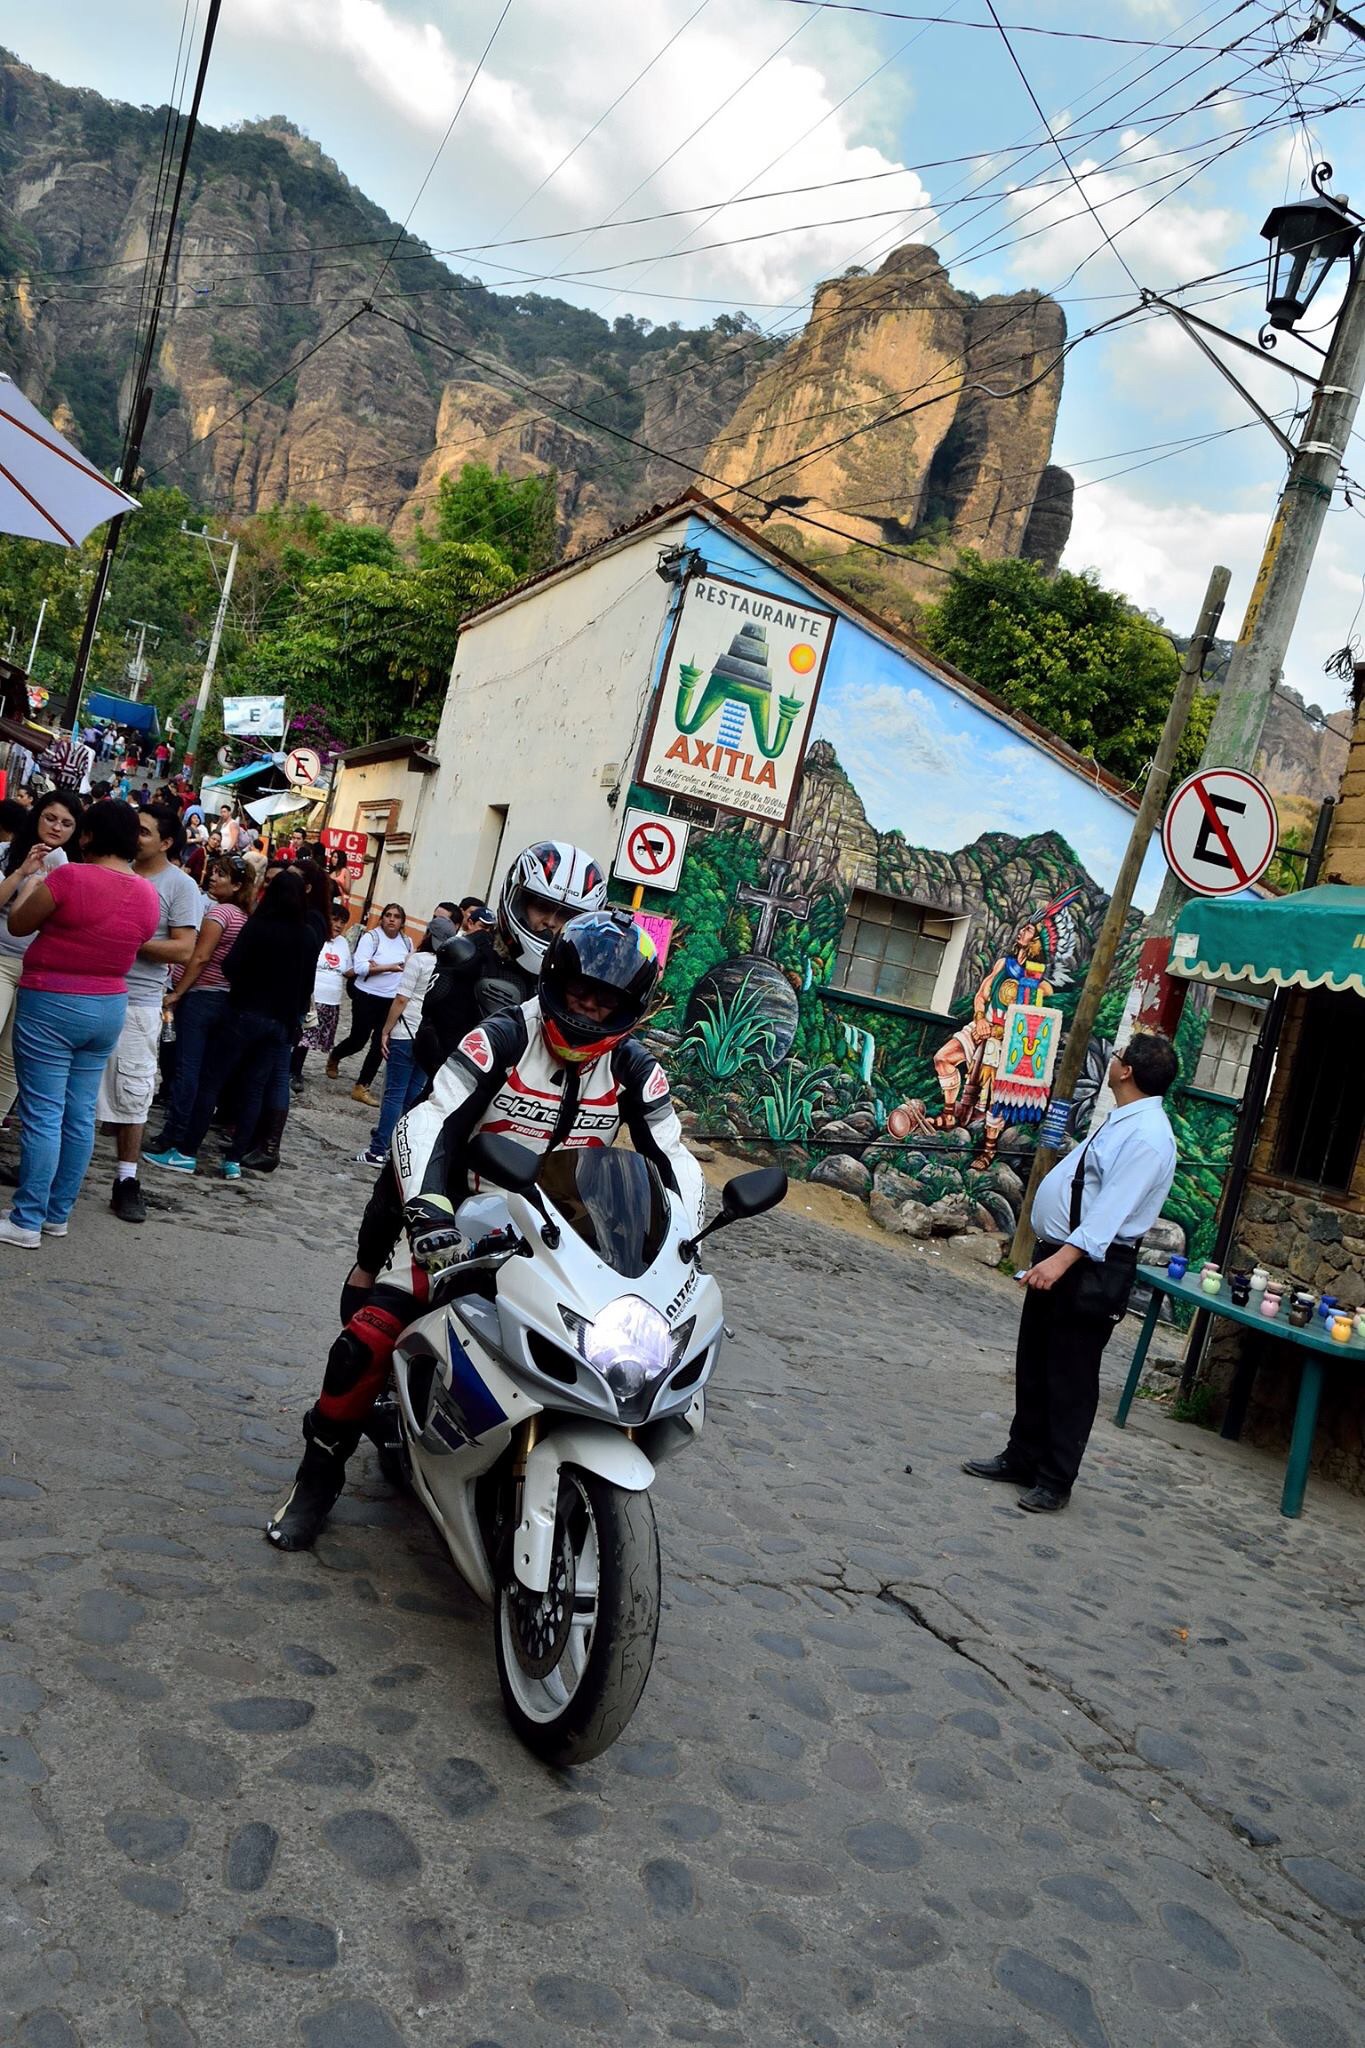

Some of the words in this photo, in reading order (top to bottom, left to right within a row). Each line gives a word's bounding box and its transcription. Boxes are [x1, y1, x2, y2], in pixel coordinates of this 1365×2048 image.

[695, 582, 821, 637] RESTAURANTE
[250, 709, 260, 722] E
[295, 757, 309, 778] E
[665, 735, 776, 789] AXITLA
[682, 785, 689, 793] y
[1193, 793, 1247, 870] E
[493, 1094, 618, 1130] alpinetars
[510, 1123, 545, 1138] racing
